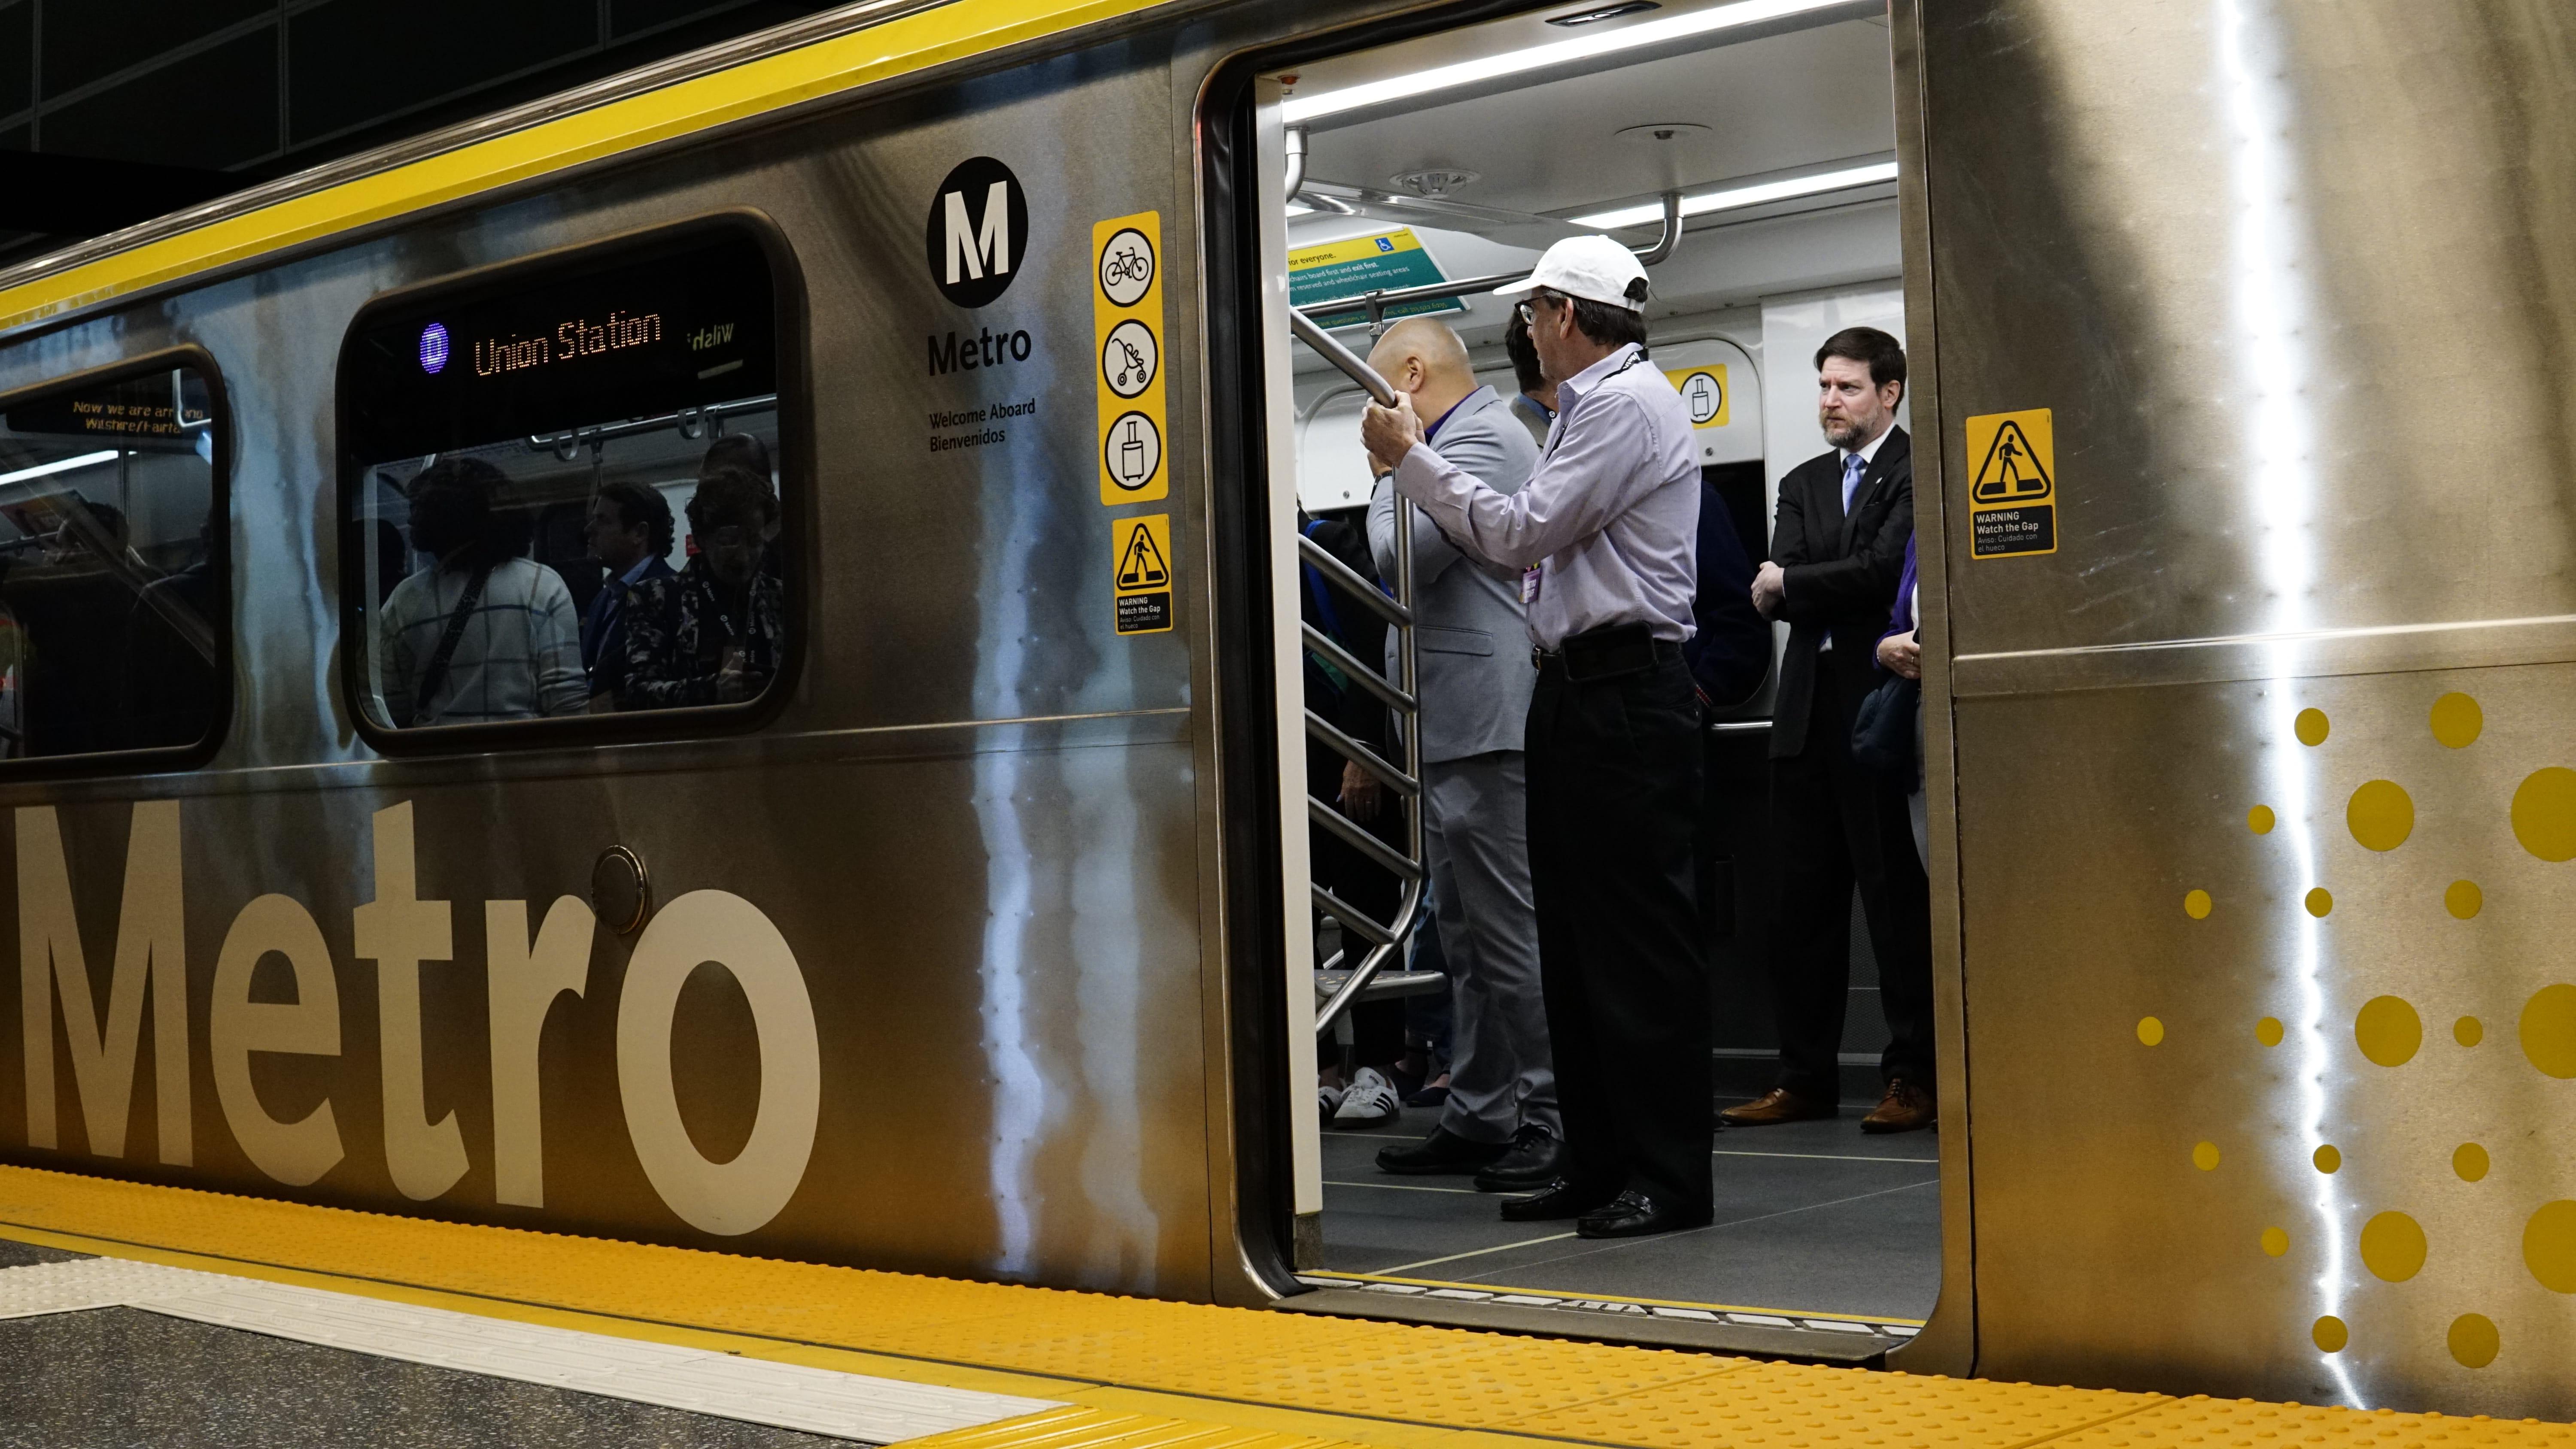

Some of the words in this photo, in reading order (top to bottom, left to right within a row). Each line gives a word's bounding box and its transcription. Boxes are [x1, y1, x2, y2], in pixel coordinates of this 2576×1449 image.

[945, 181, 1009, 284] M
[1300, 253, 1336, 263] everyone.
[1297, 281, 1322, 291] reserved
[1335, 274, 1368, 284] wheelchair
[1369, 269, 1393, 278] seating
[1306, 270, 1326, 279] board
[476, 334, 548, 376] Union
[559, 310, 660, 360] Station
[928, 327, 1031, 376] Metro
[73, 401, 103, 413] Now
[107, 405, 125, 415] we
[128, 406, 151, 417] are
[930, 409, 986, 429] Welcome
[990, 398, 1035, 420] Aboard
[930, 428, 1005, 452] Bienvenidos
[1976, 511, 2019, 523] WARNING
[1977, 524, 2003, 534] Watch
[2005, 523, 2019, 532] the
[2022, 521, 2038, 532] Gap
[1998, 534, 2024, 542] Cuidado
[1119, 597, 1148, 606] WARNING
[1119, 607, 1137, 615] Watch
[1149, 605, 1160, 613] Gap
[15, 800, 820, 1236] Metro
